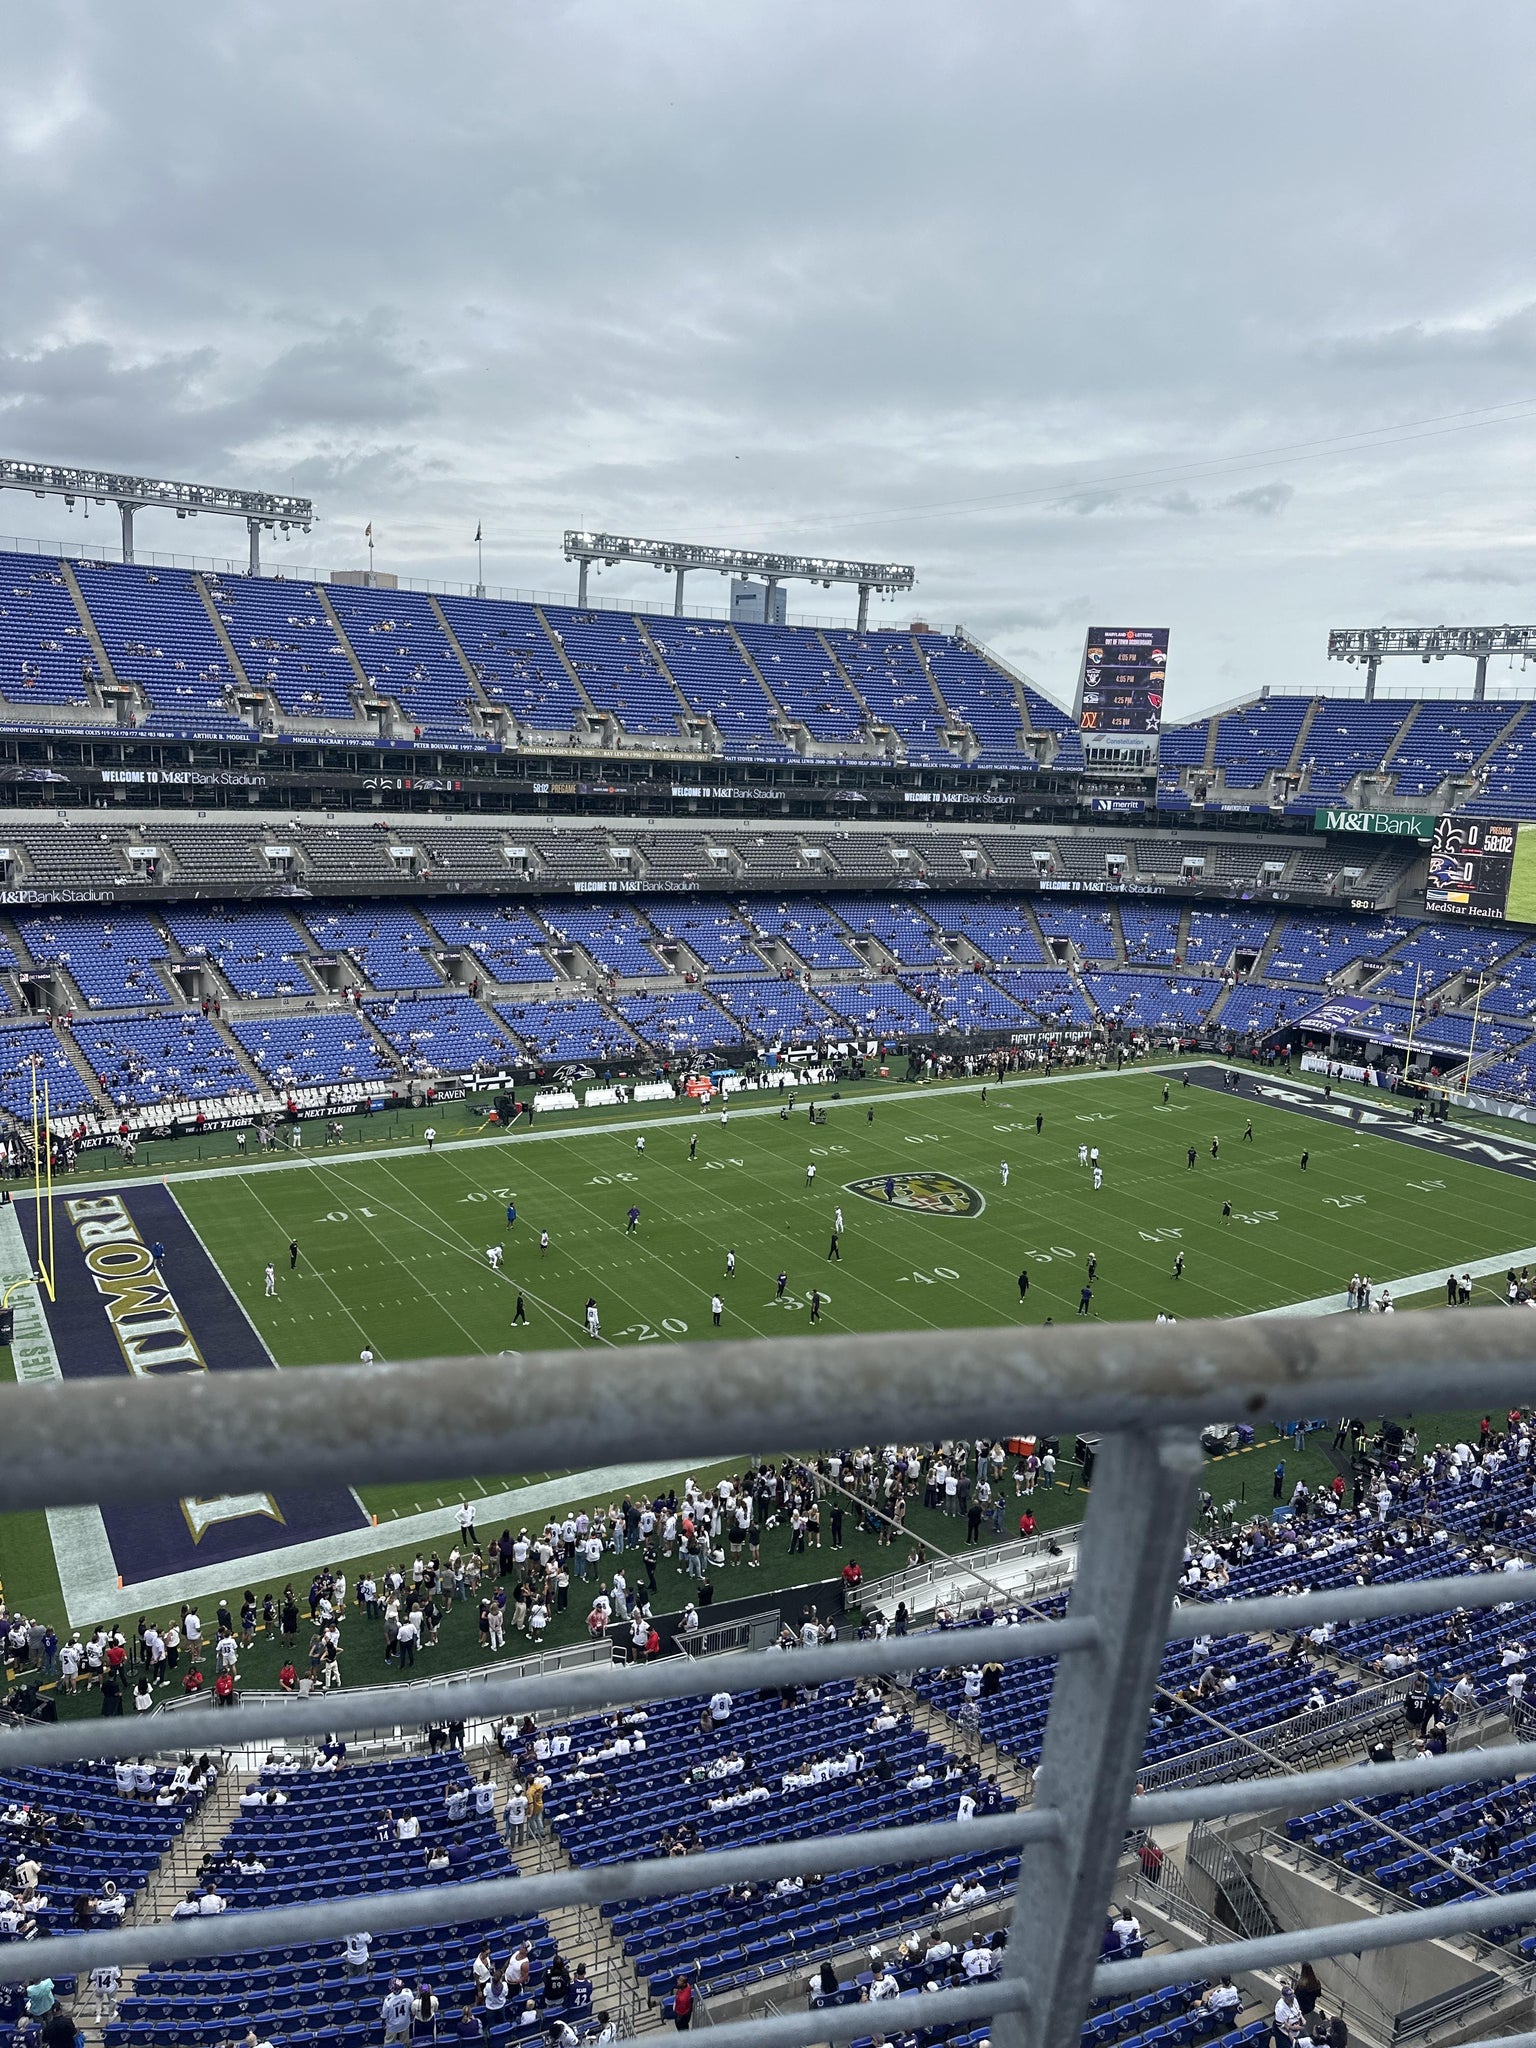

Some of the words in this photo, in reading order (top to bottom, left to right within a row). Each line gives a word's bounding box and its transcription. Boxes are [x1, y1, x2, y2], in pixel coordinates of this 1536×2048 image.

[102, 771, 144, 783] WELCOME
[147, 772, 158, 783] TO
[160, 772, 191, 784] M&T
[192, 773, 220, 784] Bank
[221, 773, 266, 785] Stadium
[533, 784, 549, 793] 58:02
[551, 784, 576, 793] PREGAME
[672, 788, 701, 797] WELCOME
[703, 788, 710, 797] TO
[713, 788, 733, 797] M&T
[733, 789, 753, 798] Bank
[753, 789, 785, 799] Stadium
[905, 793, 931, 801] WELCOME
[932, 793, 940, 802] TO
[942, 793, 962, 802] M&T
[963, 794, 982, 803] Bank
[982, 794, 1015, 804] Stadium
[1326, 811, 1374, 832] M&T
[1376, 814, 1422, 835] Bank
[1468, 826, 1478, 846] 0
[1490, 826, 1512, 835] PREGAME
[1484, 836, 1513, 853] 58:02
[1464, 862, 1473, 882] 0
[575, 881, 606, 891] WELCOME
[609, 882, 617, 891] TO
[620, 881, 642, 891] M&T
[643, 881, 663, 891] Bank
[665, 881, 700, 891] Stadium
[1040, 881, 1070, 890] WELCOME
[1072, 882, 1080, 890] TO
[1082, 882, 1105, 892] M&T
[1129, 883, 1165, 894] Stadium
[28, 890, 60, 902] Bank
[62, 890, 114, 902] Stadium
[1426, 902, 1466, 915] MedStar
[1469, 906, 1503, 919] Health
[438, 1089, 465, 1100] RAVEN
[304, 1109, 325, 1118] NEXT
[327, 1105, 357, 1115] FLIGHT
[221, 1118, 253, 1129] FLIGHT
[80, 1137, 103, 1148] NEXT
[1138, 1228, 1182, 1243] 40
[1025, 1247, 1076, 1263] 50
[913, 1267, 960, 1285] 40
[15, 1314, 45, 1339] ALL
[628, 1318, 689, 1342] 20
[720, 1702, 725, 1710] 8
[1414, 1701, 1423, 1709] 91
[175, 1774, 185, 1783] 20
[821, 1772, 827, 1781] 8
[989, 1796, 994, 1804] 8
[379, 1831, 389, 1841] 14
[98, 1975, 111, 1988] 14
[575, 1994, 587, 2006] 42
[395, 2007, 405, 2017] 14
